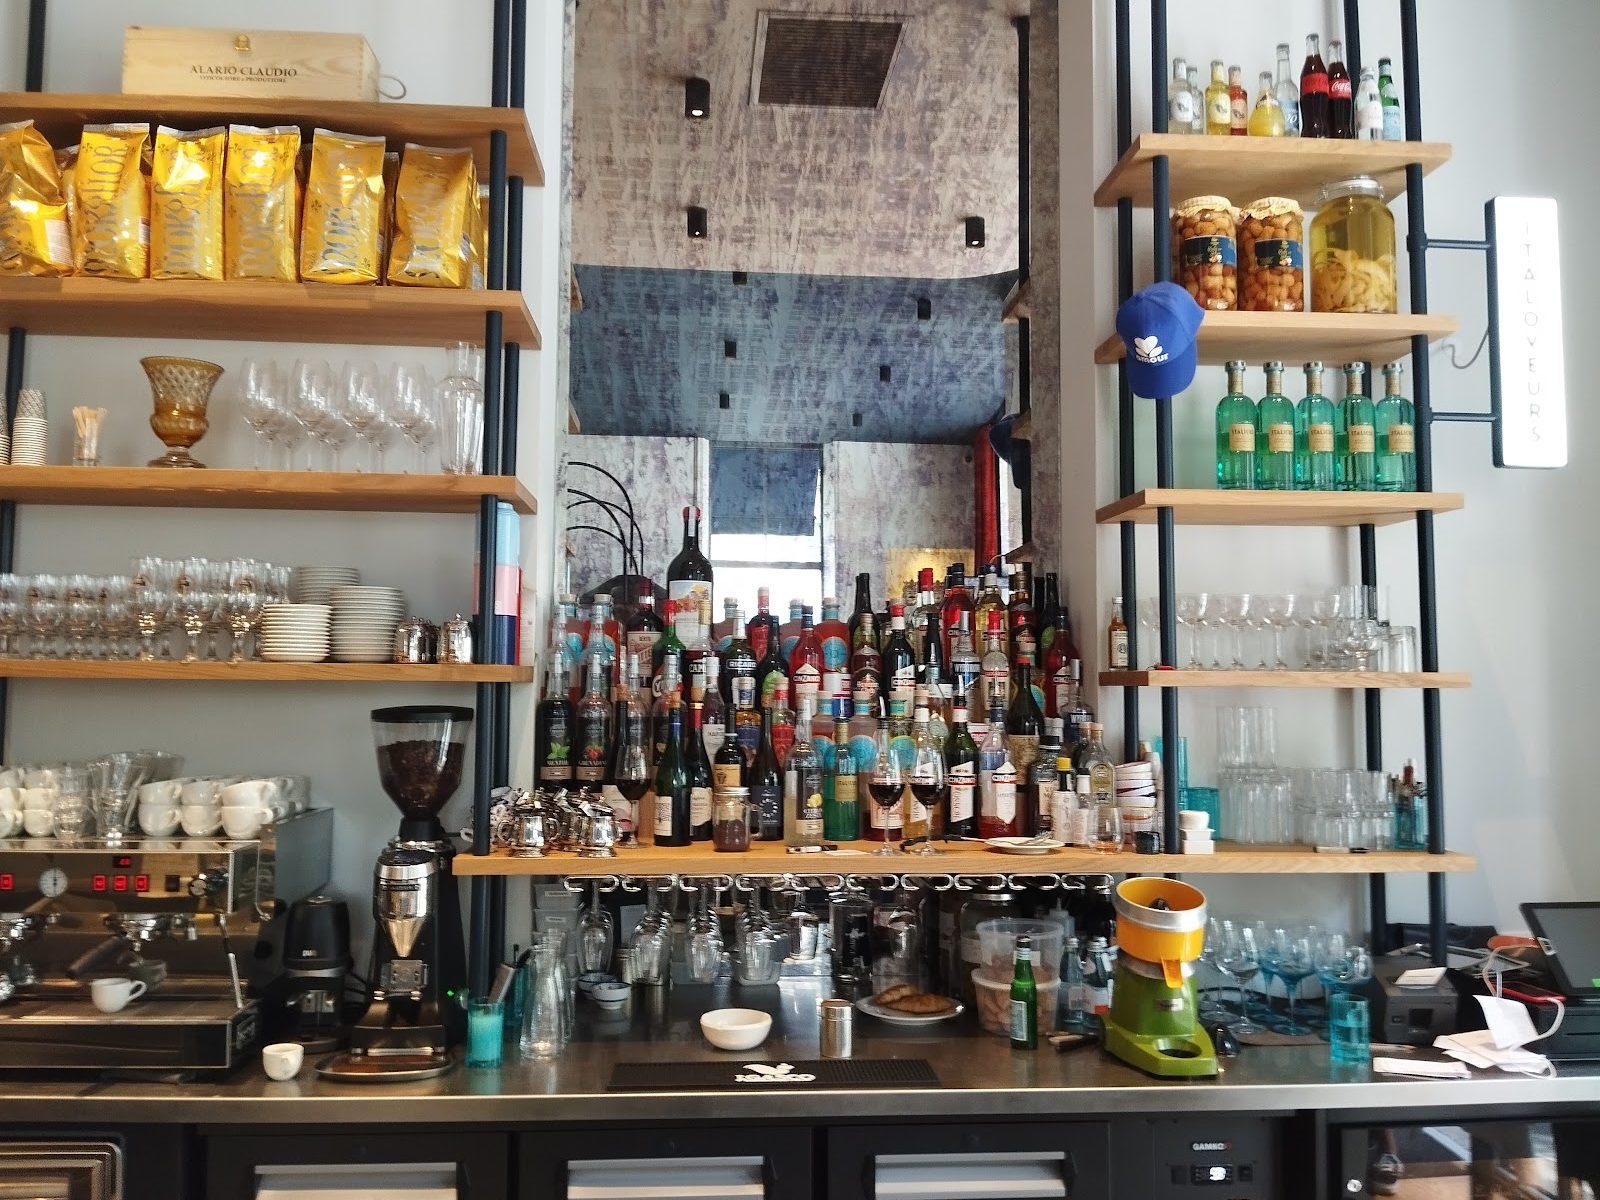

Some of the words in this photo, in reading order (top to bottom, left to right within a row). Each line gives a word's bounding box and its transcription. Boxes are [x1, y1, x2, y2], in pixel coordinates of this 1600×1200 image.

[191, 65, 238, 75] ALARIO
[240, 67, 298, 77] CLAUDIO
[1523, 222, 1541, 443] ITALOVEURS
